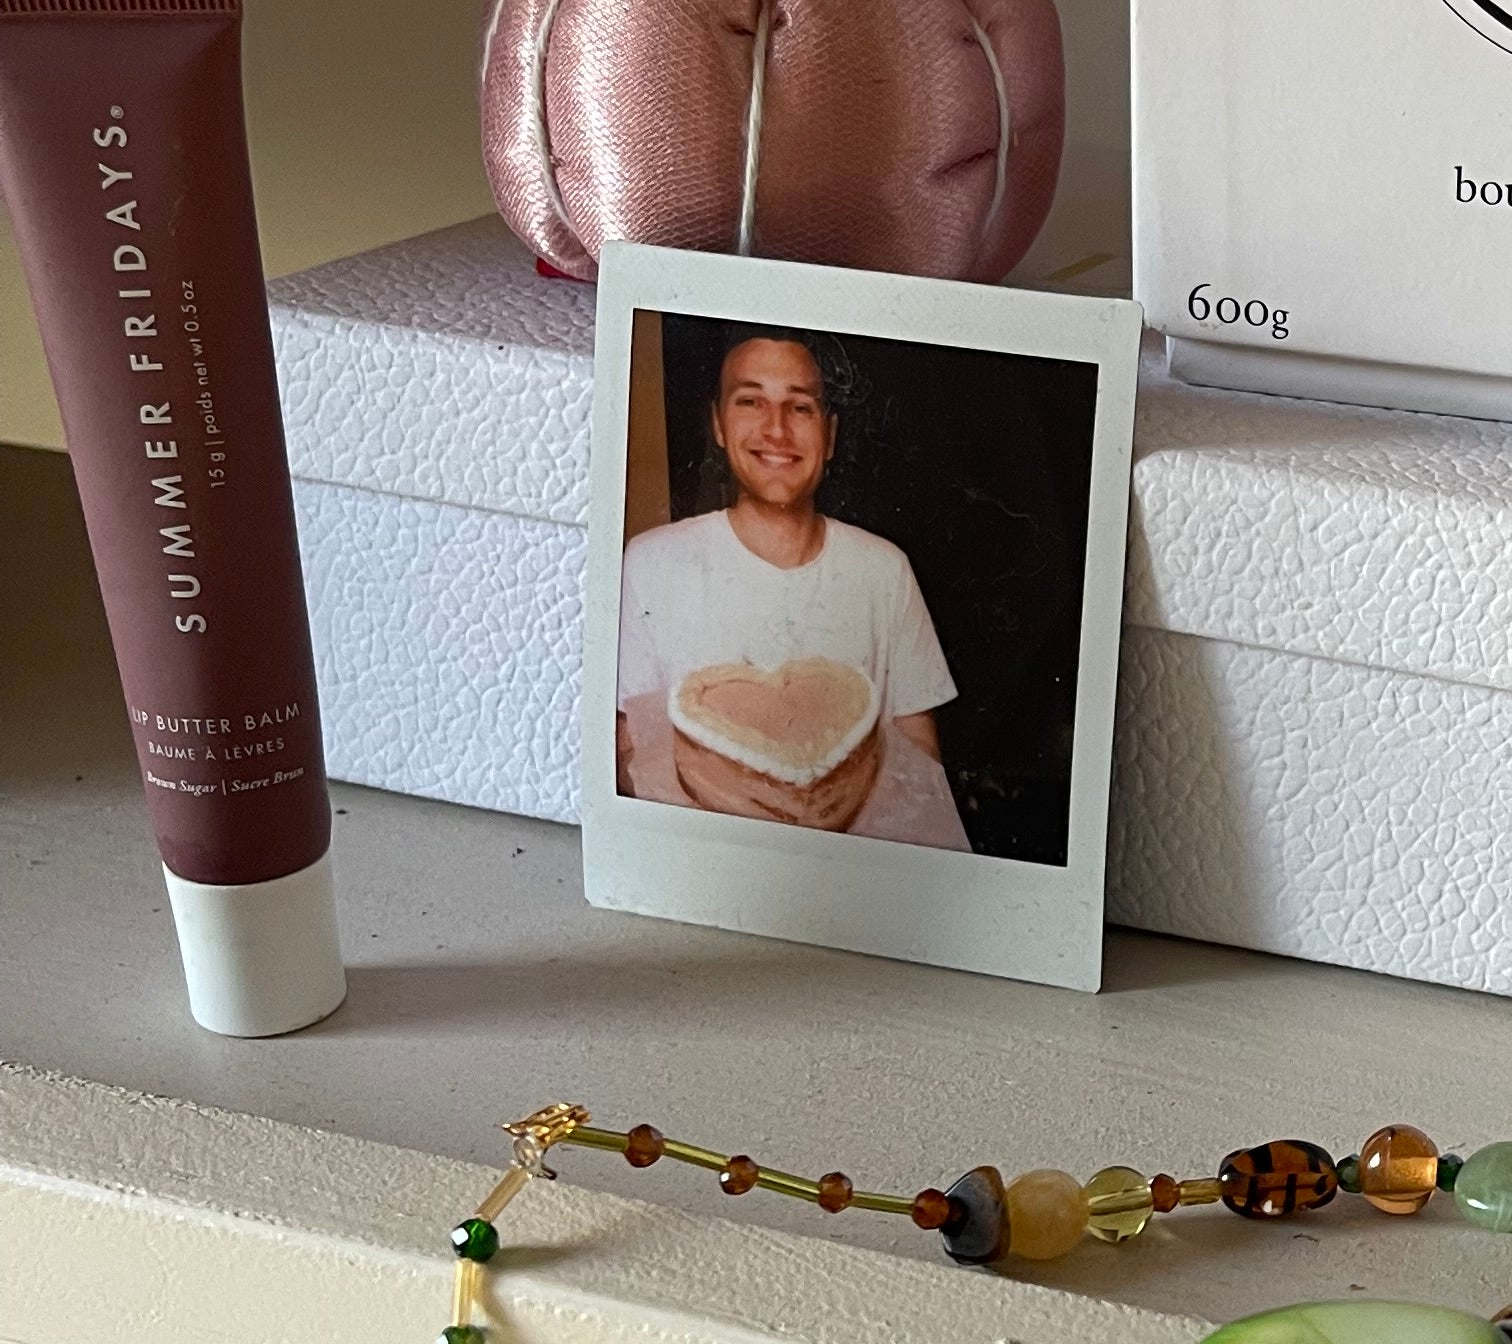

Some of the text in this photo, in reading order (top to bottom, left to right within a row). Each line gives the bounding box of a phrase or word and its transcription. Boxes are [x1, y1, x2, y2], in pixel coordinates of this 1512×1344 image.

[181, 279, 195, 300] oz
[181, 304, 200, 332] 0.5
[1187, 283, 1290, 340] 600g
[189, 337, 203, 357] wt
[193, 362, 209, 386] net
[195, 390, 222, 434] poids
[208, 467, 226, 489] 15
[140, 400, 208, 634] SUMMER
[156, 714, 231, 735] BUTTER
[244, 703, 301, 731] BALM
[148, 741, 196, 761] BAUME
[179, 779, 217, 797] Sugar
[230, 775, 270, 793] Sucre
[273, 766, 305, 784] Brun
